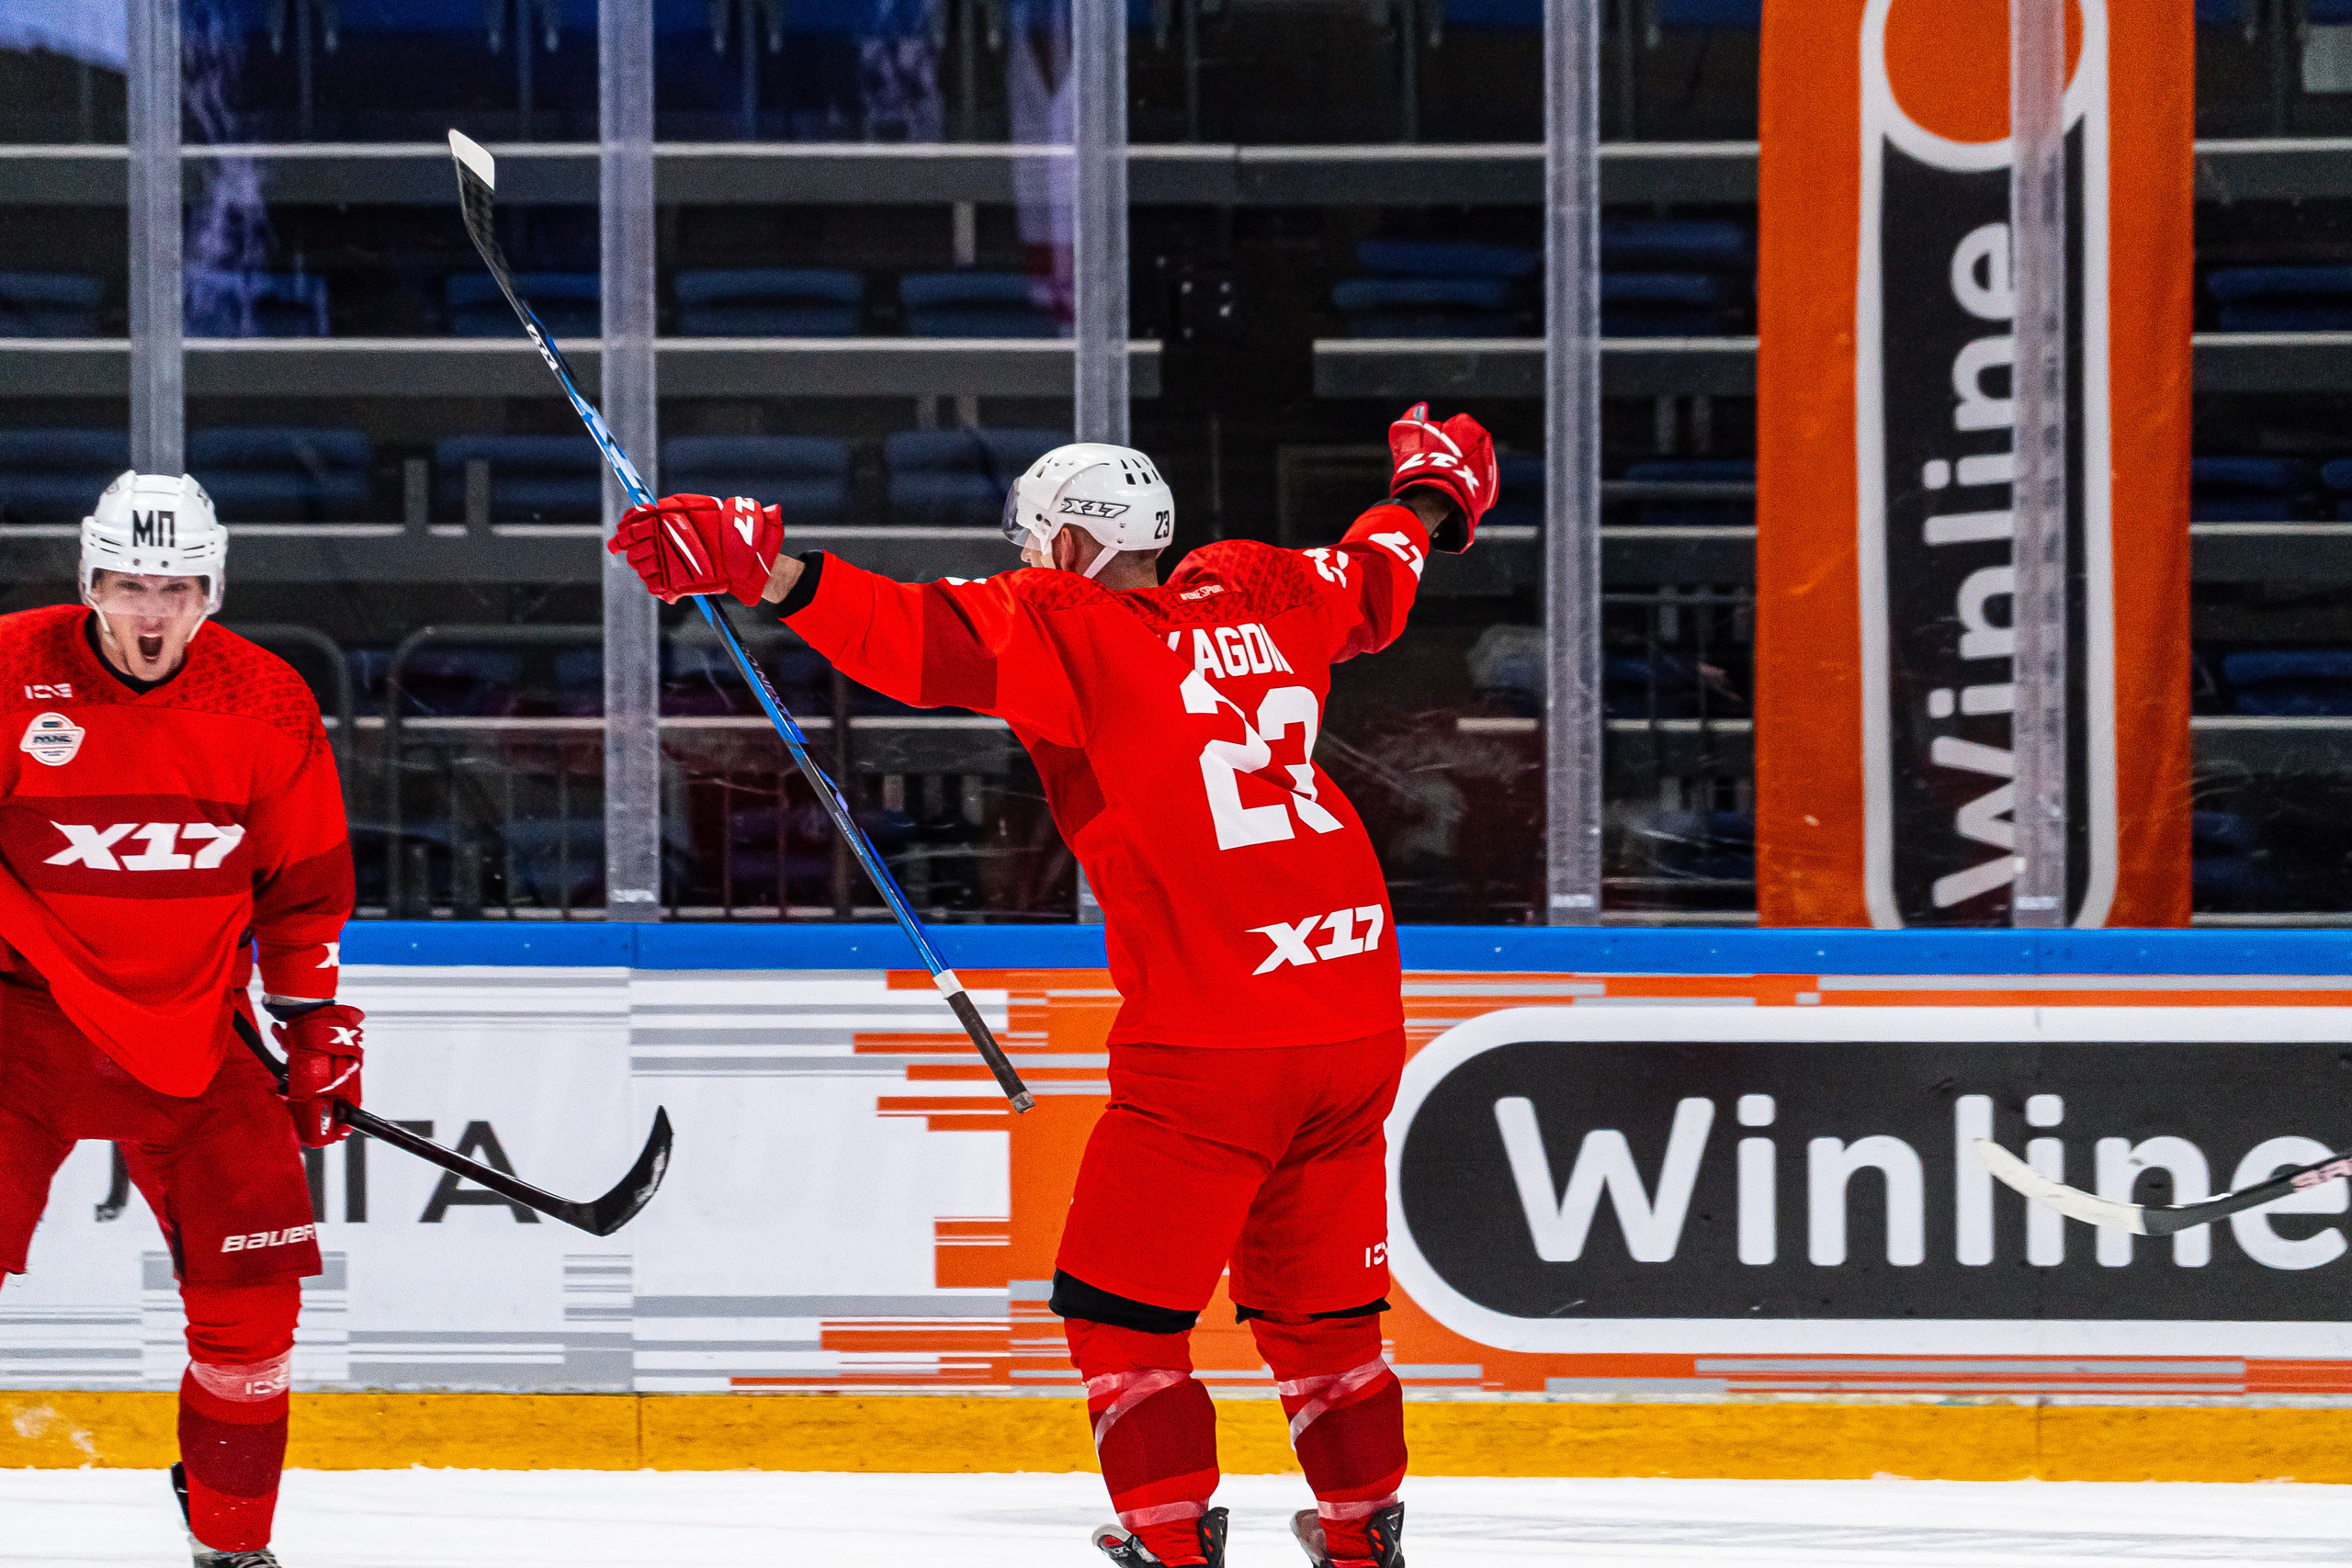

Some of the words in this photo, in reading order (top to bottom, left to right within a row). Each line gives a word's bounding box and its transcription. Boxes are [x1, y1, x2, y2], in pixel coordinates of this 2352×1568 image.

[132, 510, 175, 548] МП
[1059, 497, 1131, 519] X17
[1154, 510, 1170, 539] 23
[1923, 220, 2059, 908] Winline
[1180, 670, 1345, 851] 23
[42, 820, 246, 871] X17
[1245, 904, 1384, 976] X17
[1495, 1094, 2348, 1270] Winline
